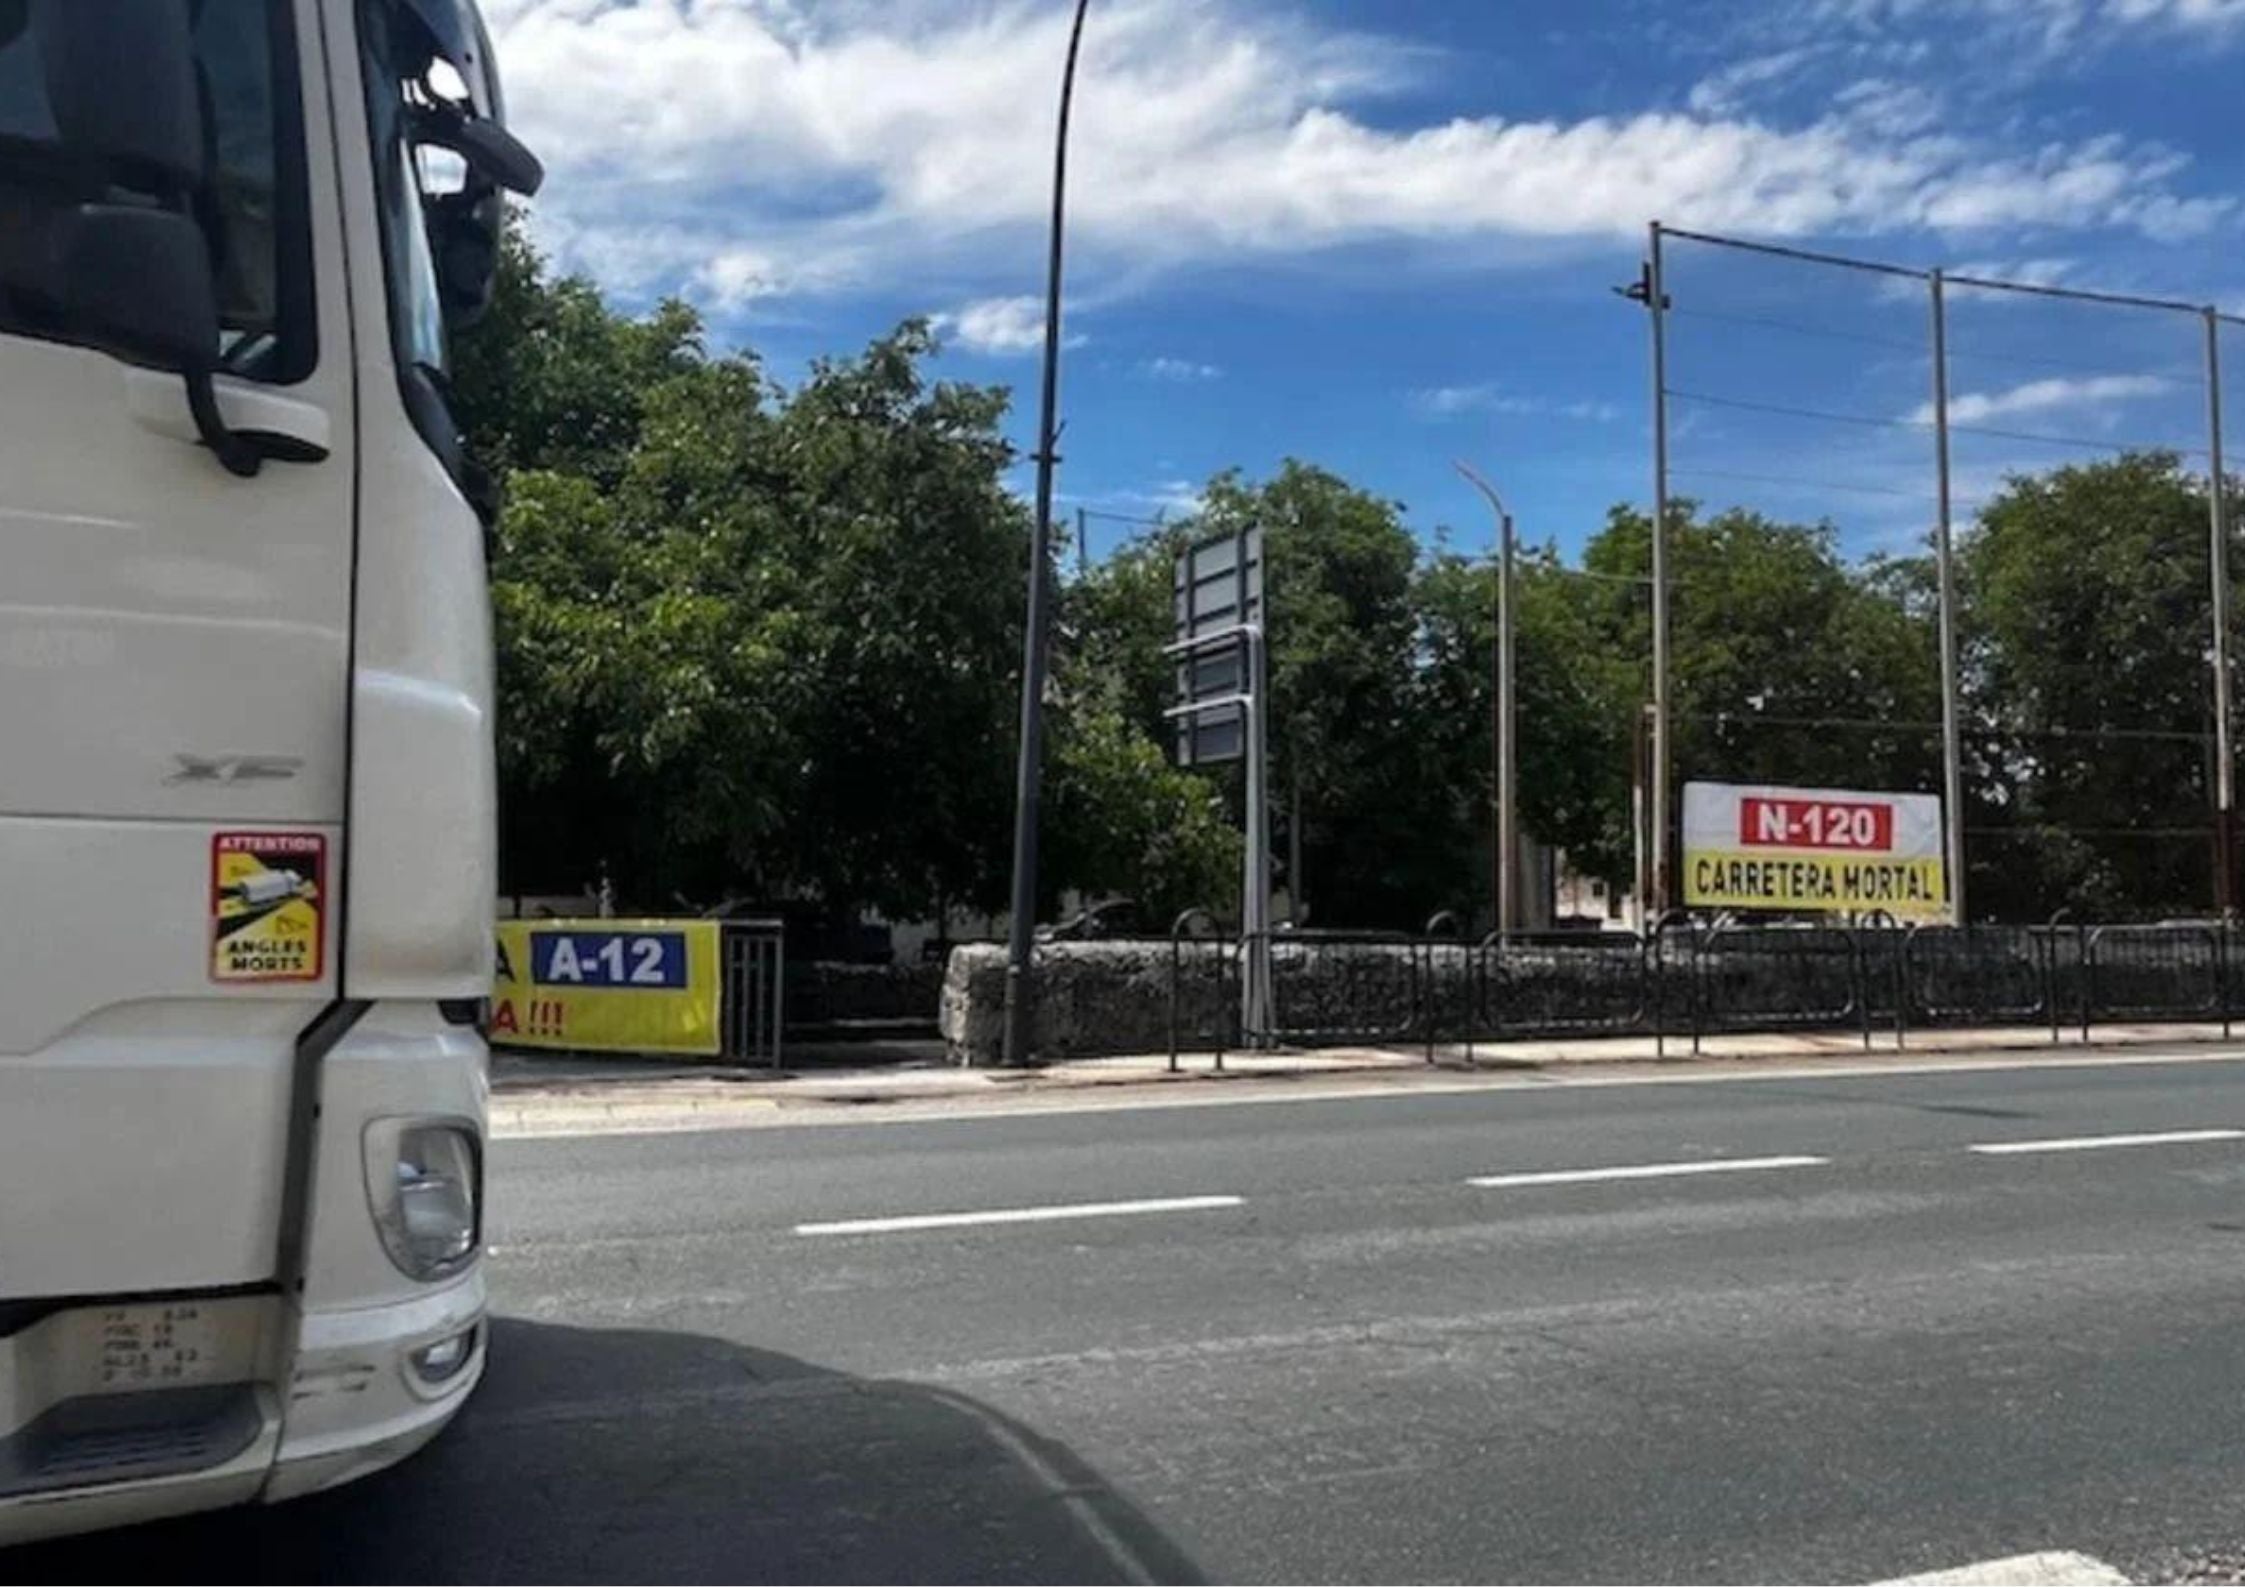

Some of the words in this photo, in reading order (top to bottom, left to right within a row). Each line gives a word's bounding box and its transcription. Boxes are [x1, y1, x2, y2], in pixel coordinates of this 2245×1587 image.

[1757, 803, 1876, 845] N-120
[219, 836, 321, 850] ATTENTION
[1696, 858, 1836, 899] CARRETERA
[1843, 862, 1933, 900] MORTAL
[229, 940, 307, 953] ANGLES
[547, 936, 665, 982] A-12
[231, 957, 303, 971] MORTS
